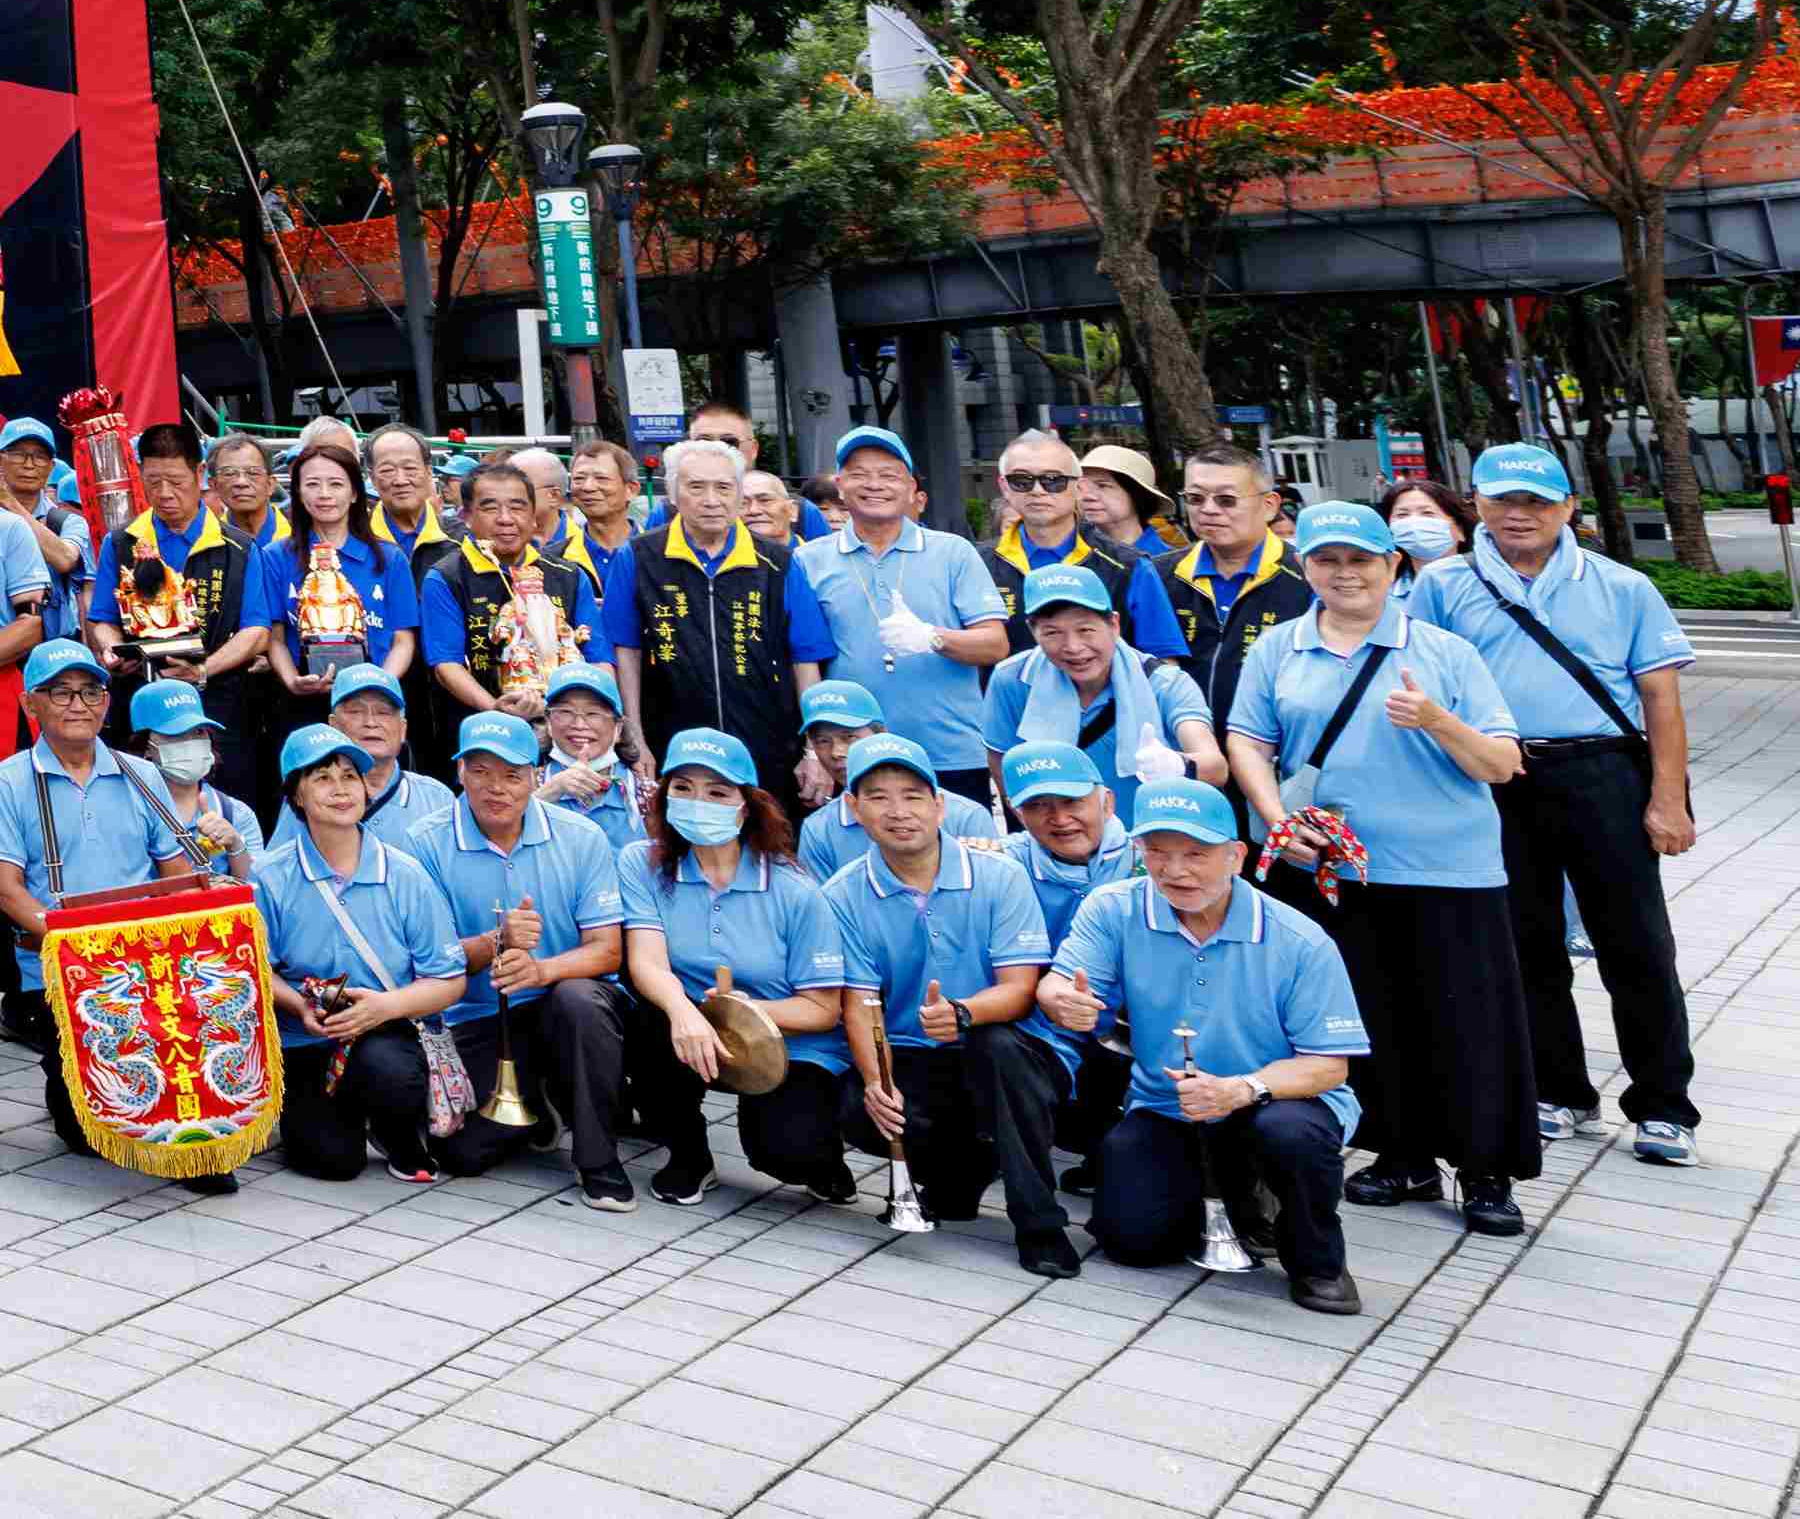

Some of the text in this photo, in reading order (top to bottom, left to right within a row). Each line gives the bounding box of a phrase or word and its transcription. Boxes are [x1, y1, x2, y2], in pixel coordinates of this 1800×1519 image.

[538, 198, 553, 218] 9
[570, 195, 587, 216] 9
[1498, 459, 1545, 475] HAKKA
[1311, 513, 1361, 528] HAKKA
[1039, 574, 1083, 589] HAKKA
[48, 647, 84, 660] HAKKA
[164, 693, 198, 709] HAKKA
[471, 723, 512, 739] HAKKA
[681, 740, 726, 757] HAKKA
[864, 740, 912, 756] HAKKA
[1015, 758, 1061, 778] HAKKA
[1148, 795, 1201, 813] HAKKA
